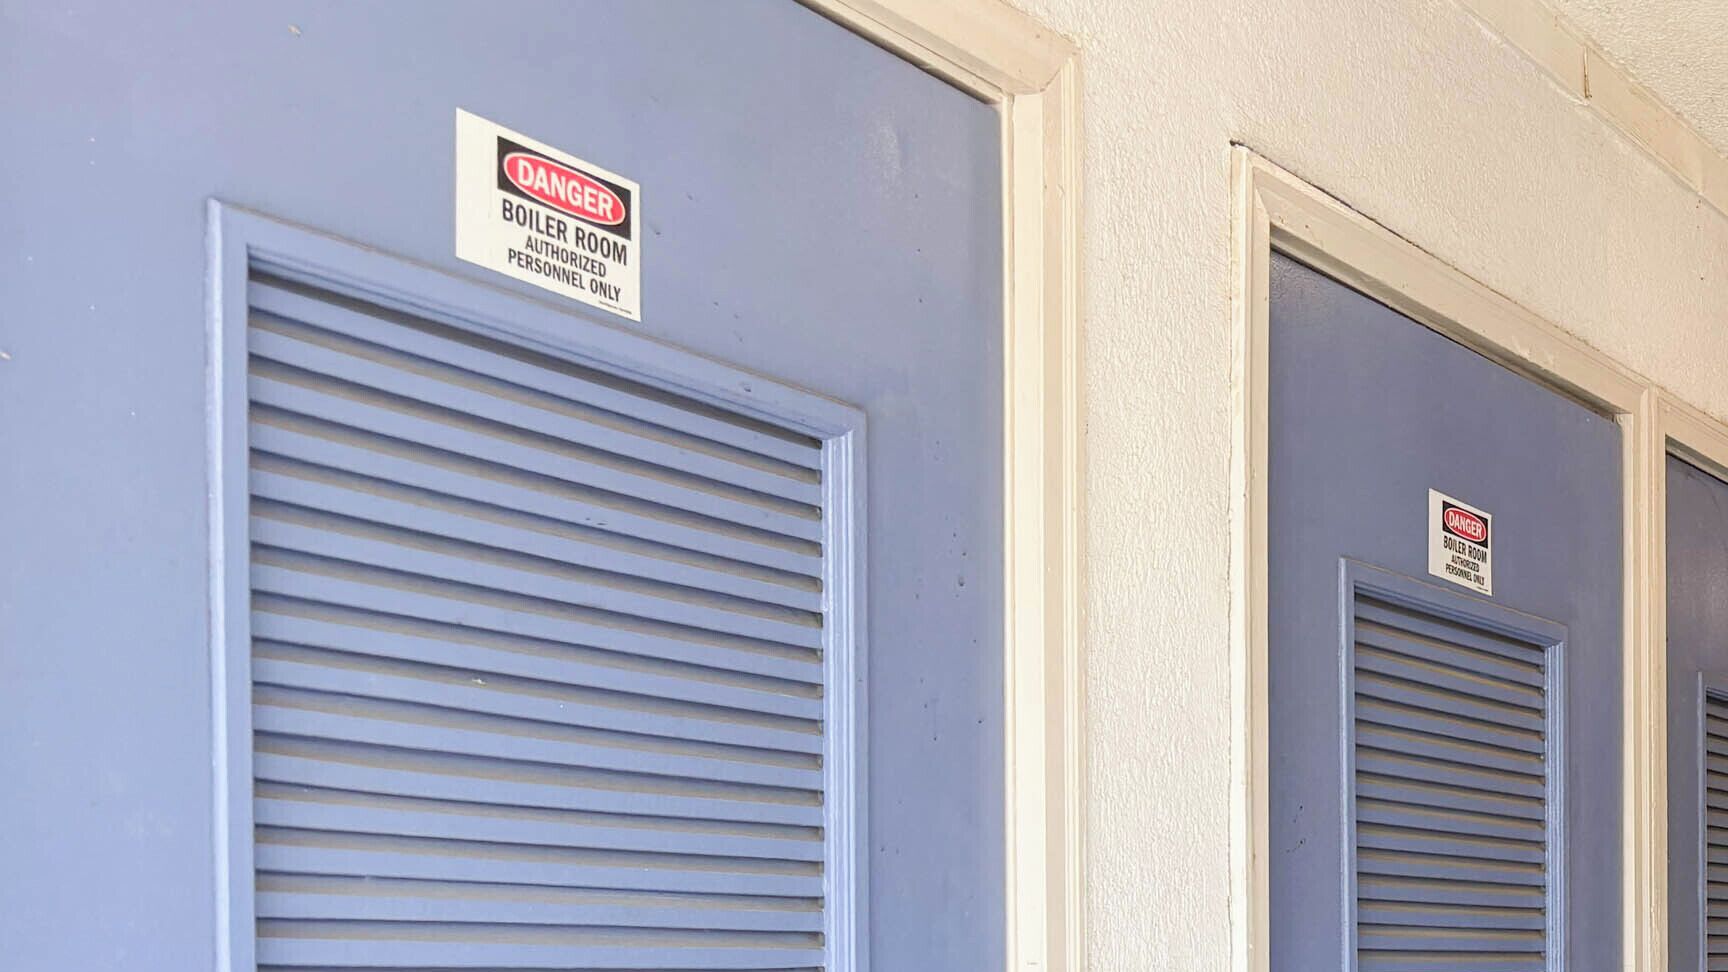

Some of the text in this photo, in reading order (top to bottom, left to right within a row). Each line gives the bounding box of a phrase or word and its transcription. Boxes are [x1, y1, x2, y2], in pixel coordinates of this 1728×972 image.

[517, 158, 614, 221] DANGER
[502, 198, 628, 267] BOILER ROOM
[525, 234, 607, 278] AUTHORIZED
[508, 248, 621, 302] PERSONNEL ONLY
[1448, 511, 1482, 539] DANGER
[1443, 535, 1487, 564] BOILER ROOM
[1451, 555, 1480, 573] AUTHORIZED
[1445, 563, 1485, 586] PERSONNEL ONLY
